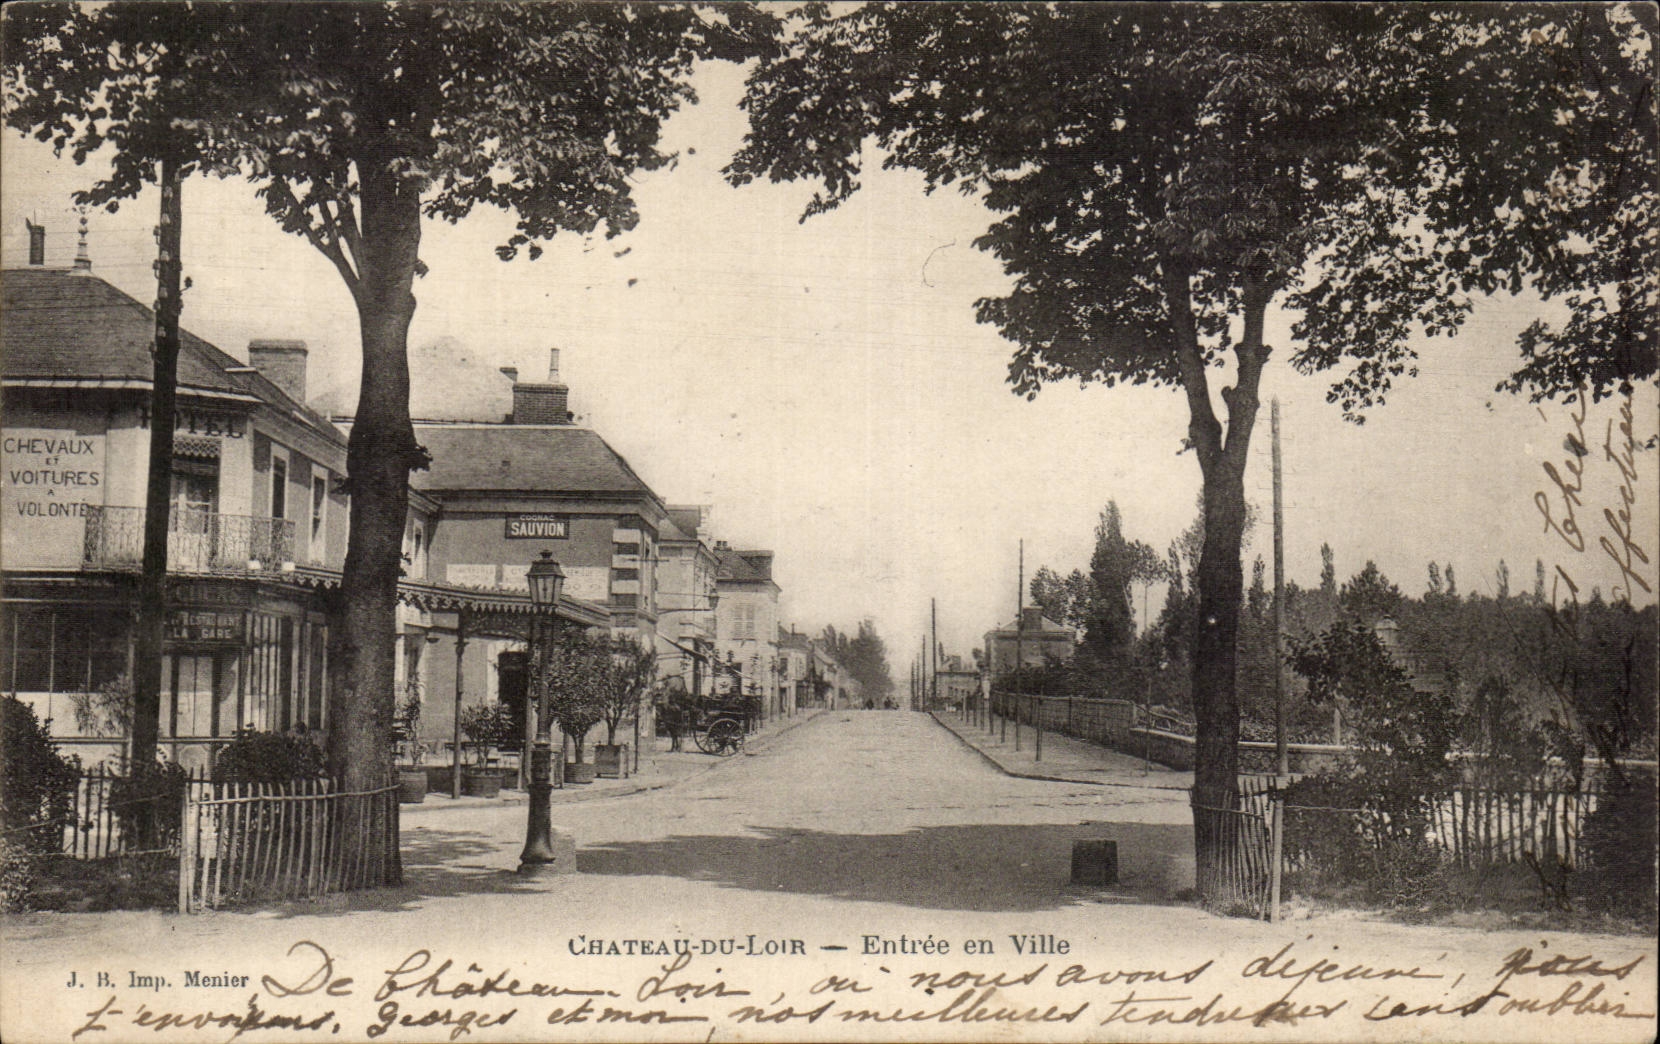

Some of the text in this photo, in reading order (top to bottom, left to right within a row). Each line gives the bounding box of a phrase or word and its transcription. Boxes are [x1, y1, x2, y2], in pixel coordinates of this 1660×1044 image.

[141, 405, 244, 439] HTEL
[4, 437, 94, 455] CHEVAUX
[45, 457, 59, 466] ET
[10, 470, 100, 486] VOITURES
[511, 522, 565, 537] SAUVION
[909, 963, 1048, 988] nous
[1056, 961, 1214, 987] avons
[366, 1001, 518, 1040] Georges
[548, 998, 595, 1025] et
